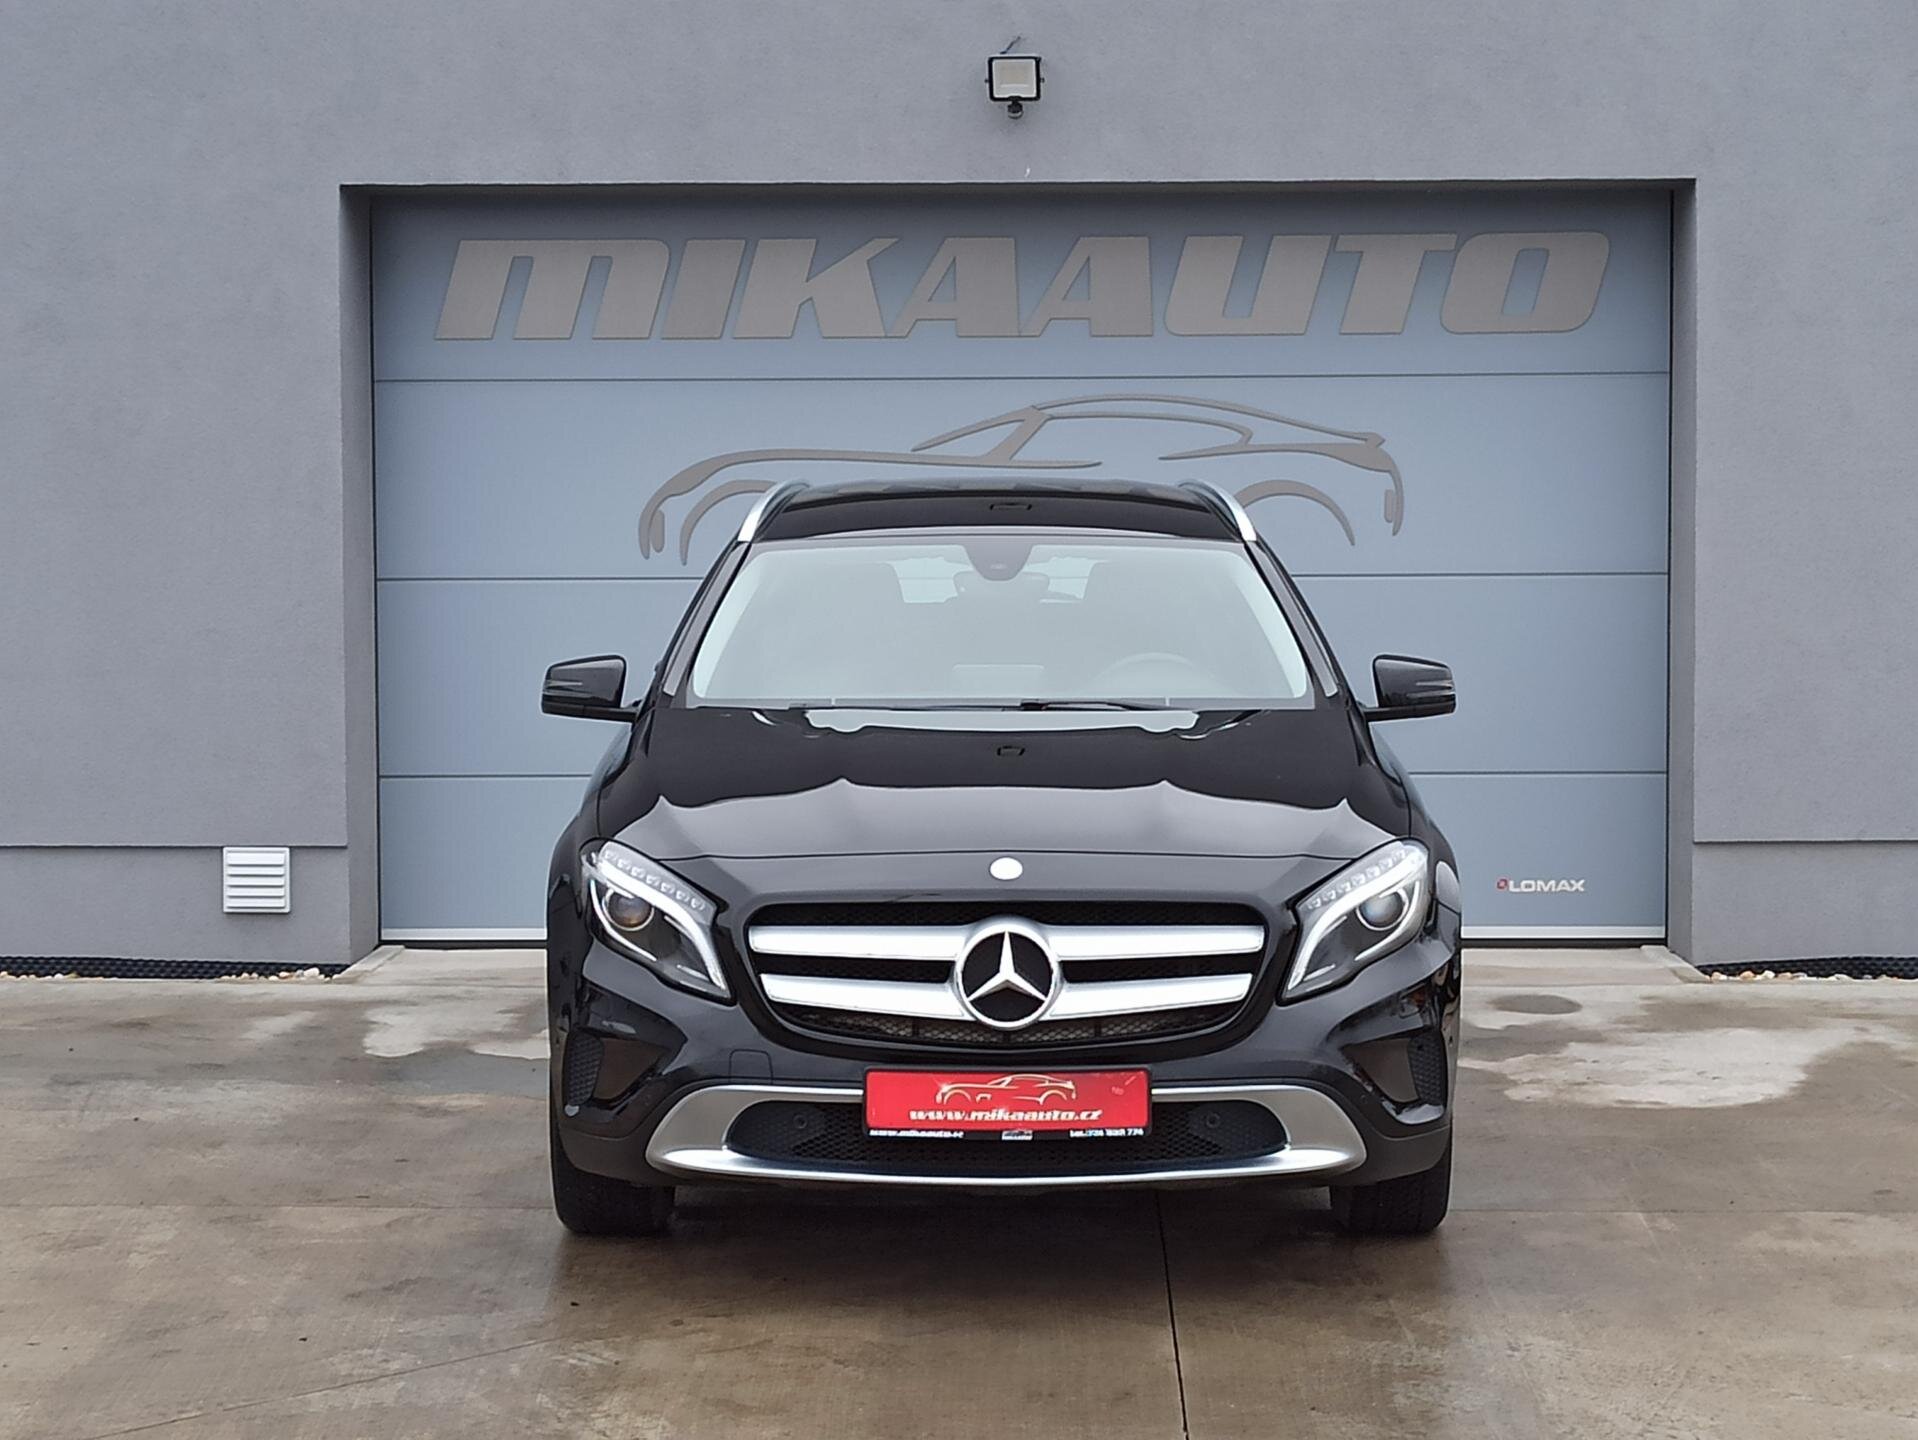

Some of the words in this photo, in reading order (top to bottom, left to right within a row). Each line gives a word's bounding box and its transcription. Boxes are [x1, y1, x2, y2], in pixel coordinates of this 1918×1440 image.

[434, 232, 1610, 340] MIKAAUTO
[1508, 879, 1585, 892] LOMAX
[908, 1107, 1103, 1122] www.mikaauto.cz
